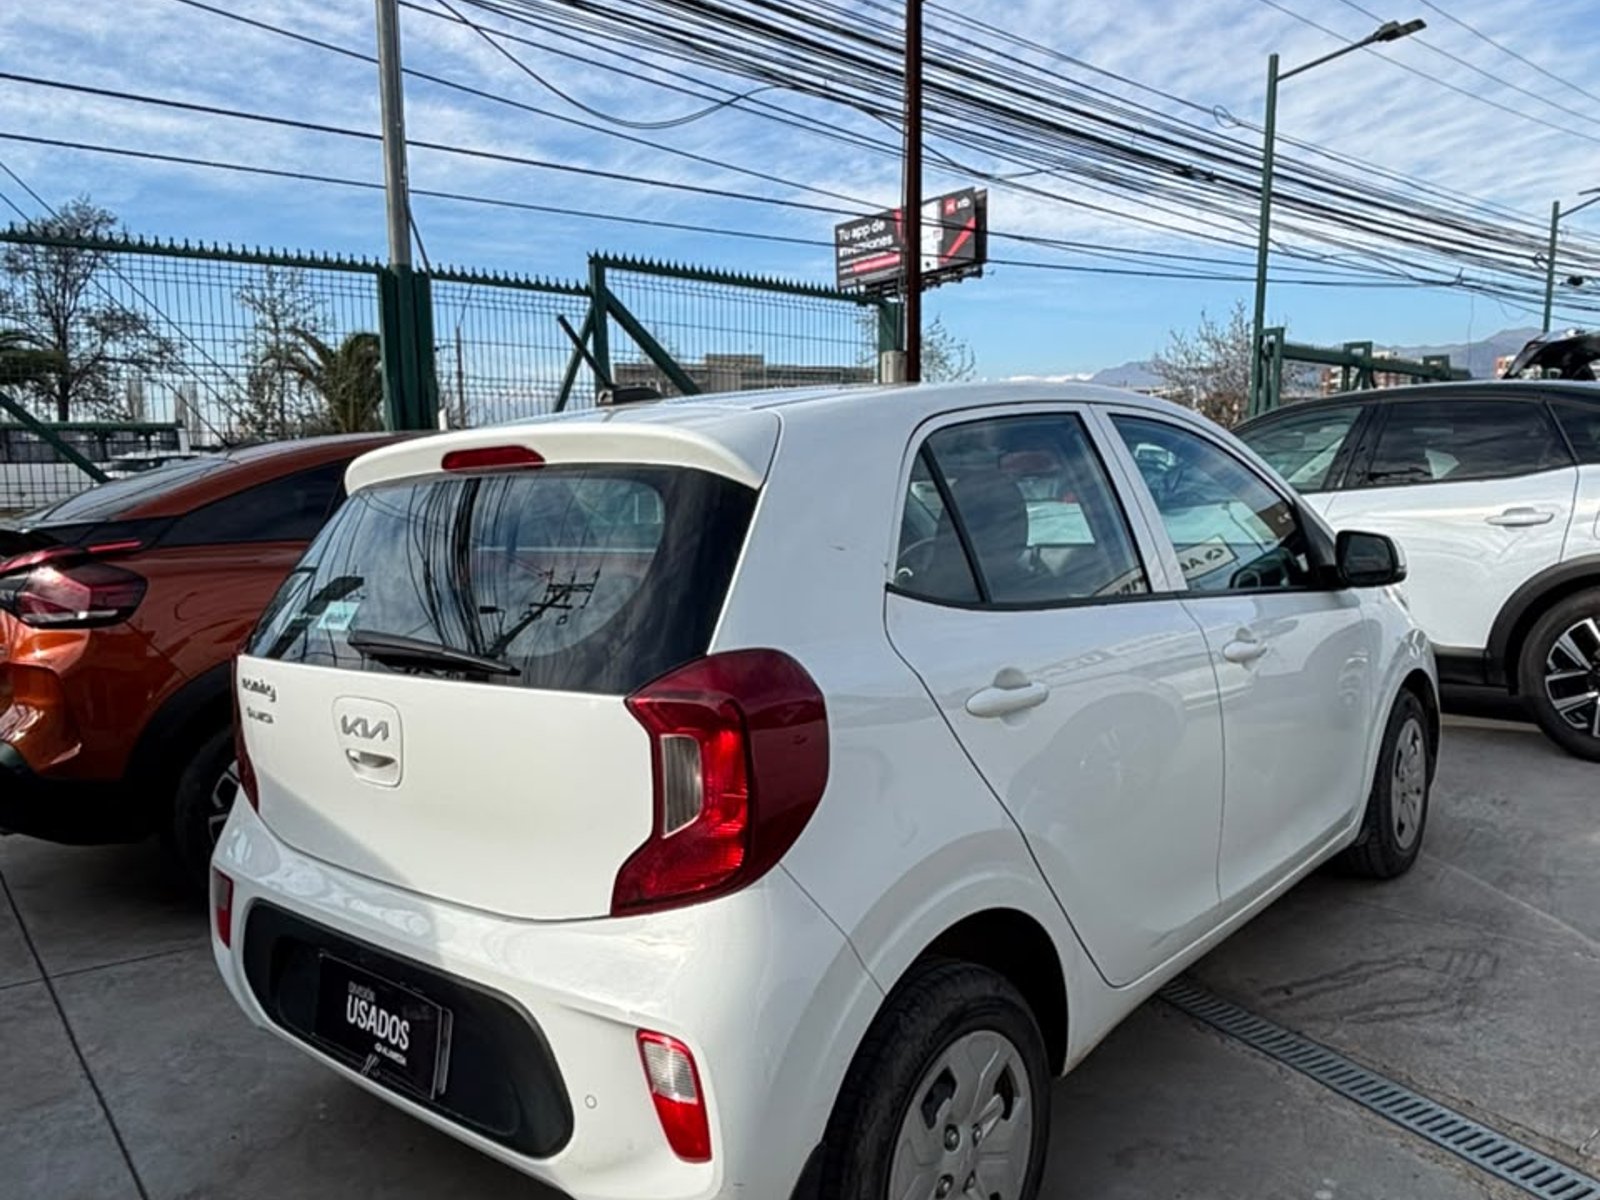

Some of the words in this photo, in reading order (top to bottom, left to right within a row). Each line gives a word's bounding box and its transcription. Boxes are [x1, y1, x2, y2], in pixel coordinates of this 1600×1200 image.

[838, 228, 850, 242] Tu
[851, 223, 871, 240] app
[871, 219, 886, 233] de
[341, 714, 389, 741] KIA
[346, 994, 410, 1051] USADOS
